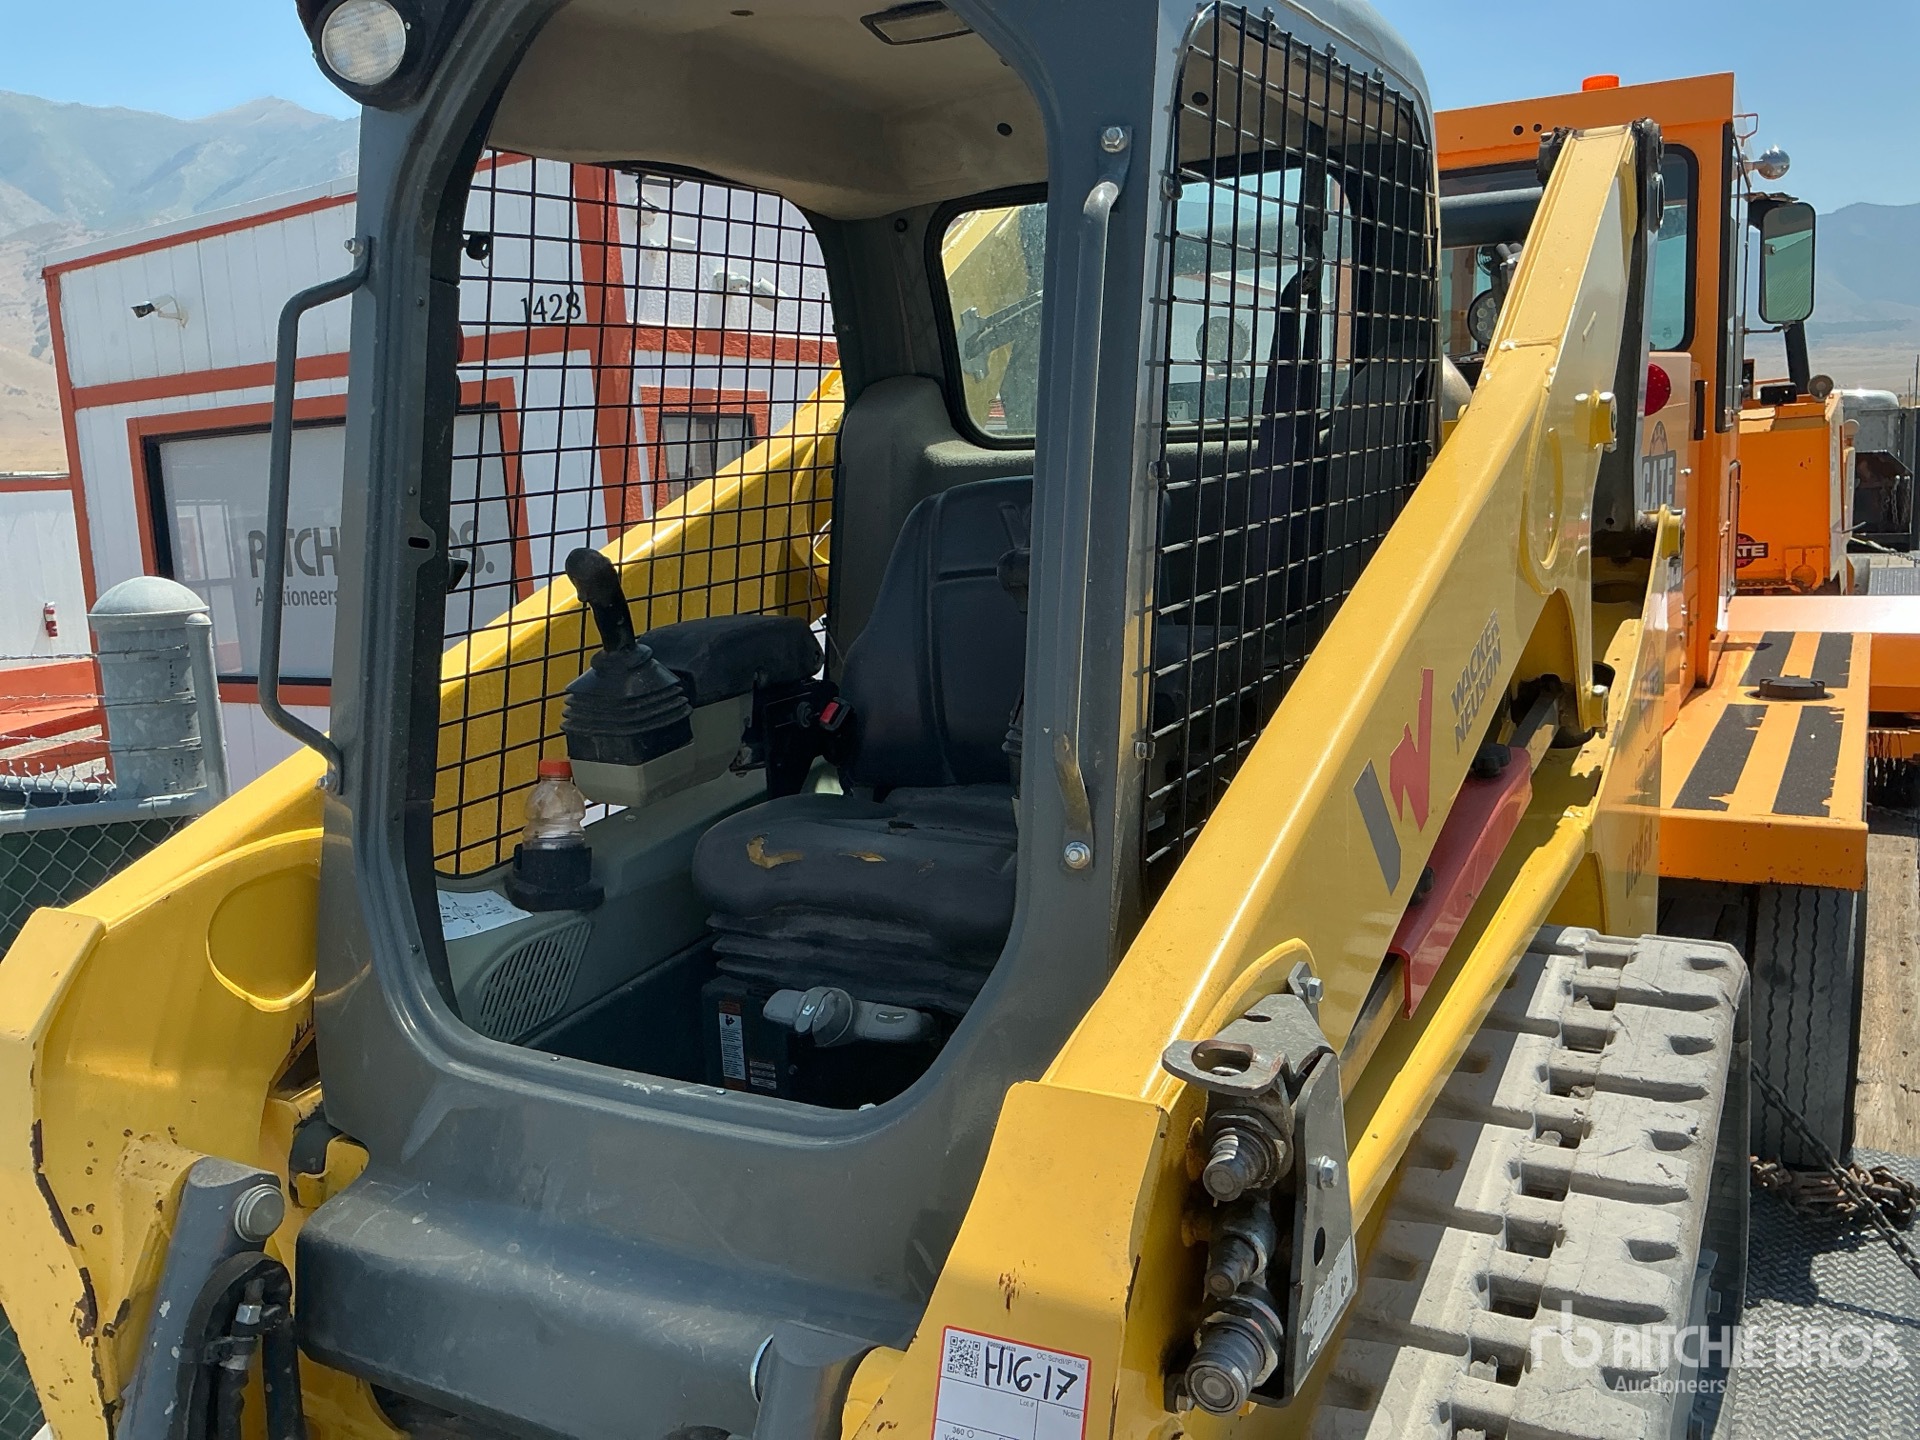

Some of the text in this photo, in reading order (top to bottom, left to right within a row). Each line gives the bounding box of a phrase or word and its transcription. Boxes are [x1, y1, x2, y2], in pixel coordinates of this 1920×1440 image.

[521, 292, 581, 322] 1428
[1450, 608, 1500, 716] WACKER
[1455, 636, 1502, 755] NEUSON
[984, 1345, 1079, 1401] H16-17
[1062, 1409, 1080, 1420] Notes
